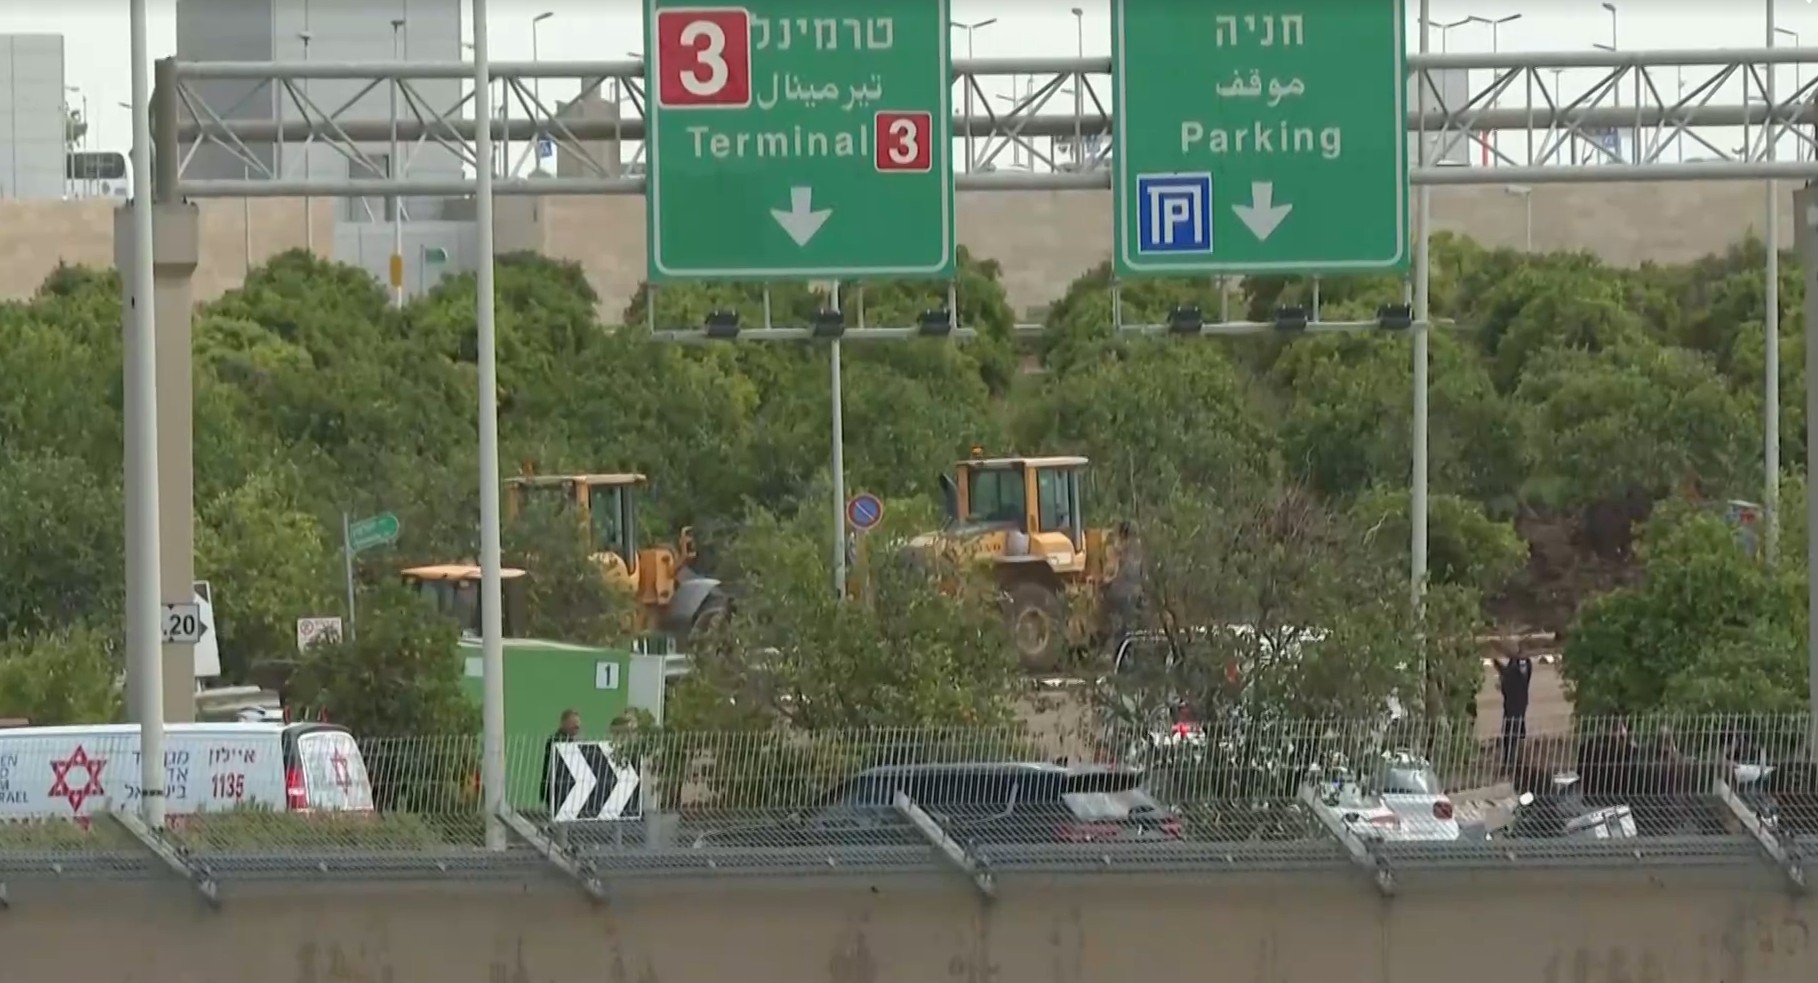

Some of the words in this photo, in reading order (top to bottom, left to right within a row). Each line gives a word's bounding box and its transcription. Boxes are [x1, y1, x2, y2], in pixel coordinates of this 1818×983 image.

[750, 13, 894, 50] טרמינל
[1215, 14, 1304, 47] חניה
[679, 20, 729, 96] 3
[756, 72, 882, 110] تيرمينال
[1215, 69, 1305, 107] موقف
[686, 125, 868, 158] Terminal
[888, 118, 919, 164] 3
[1180, 121, 1342, 159] Parking
[161, 613, 195, 636] .20
[604, 663, 611, 687] 1
[211, 773, 246, 799] 1135
